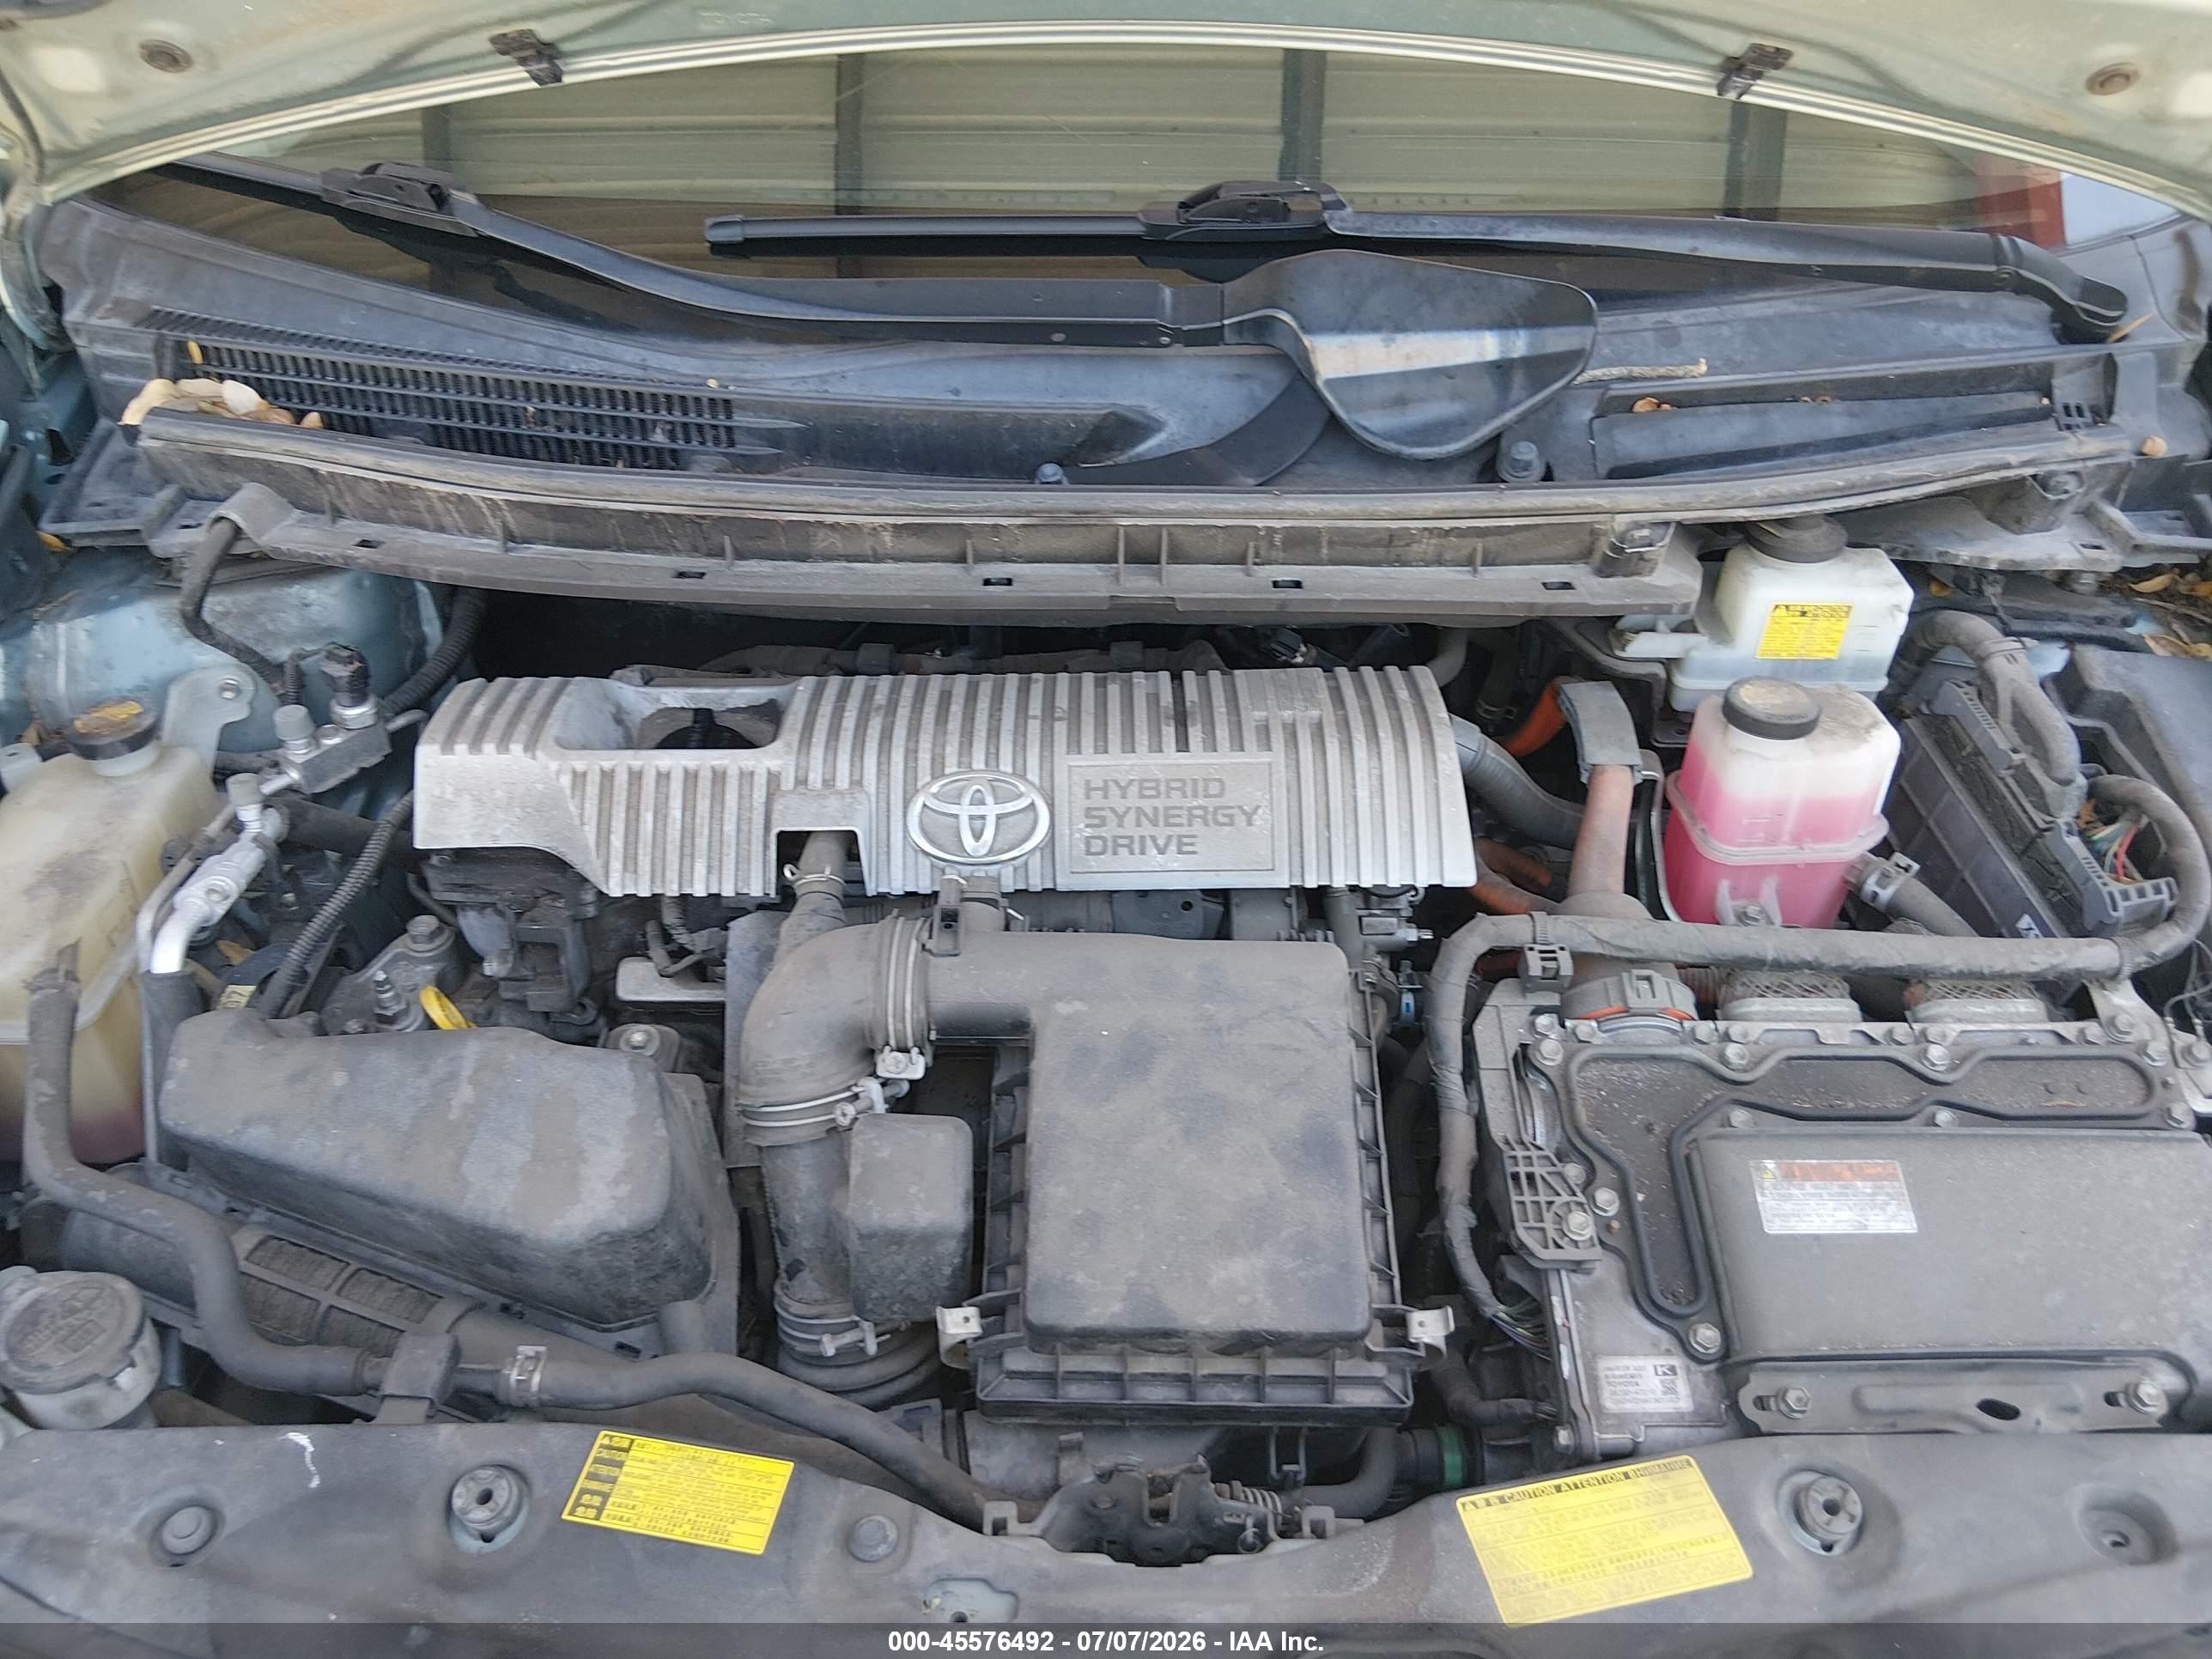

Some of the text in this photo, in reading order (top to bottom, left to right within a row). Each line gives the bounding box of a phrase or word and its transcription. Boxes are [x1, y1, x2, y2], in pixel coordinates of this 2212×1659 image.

[1085, 777, 1226, 799] HYBRID
[1085, 805, 1262, 828] SYNERGY
[1085, 834, 1199, 856] DRIVE
